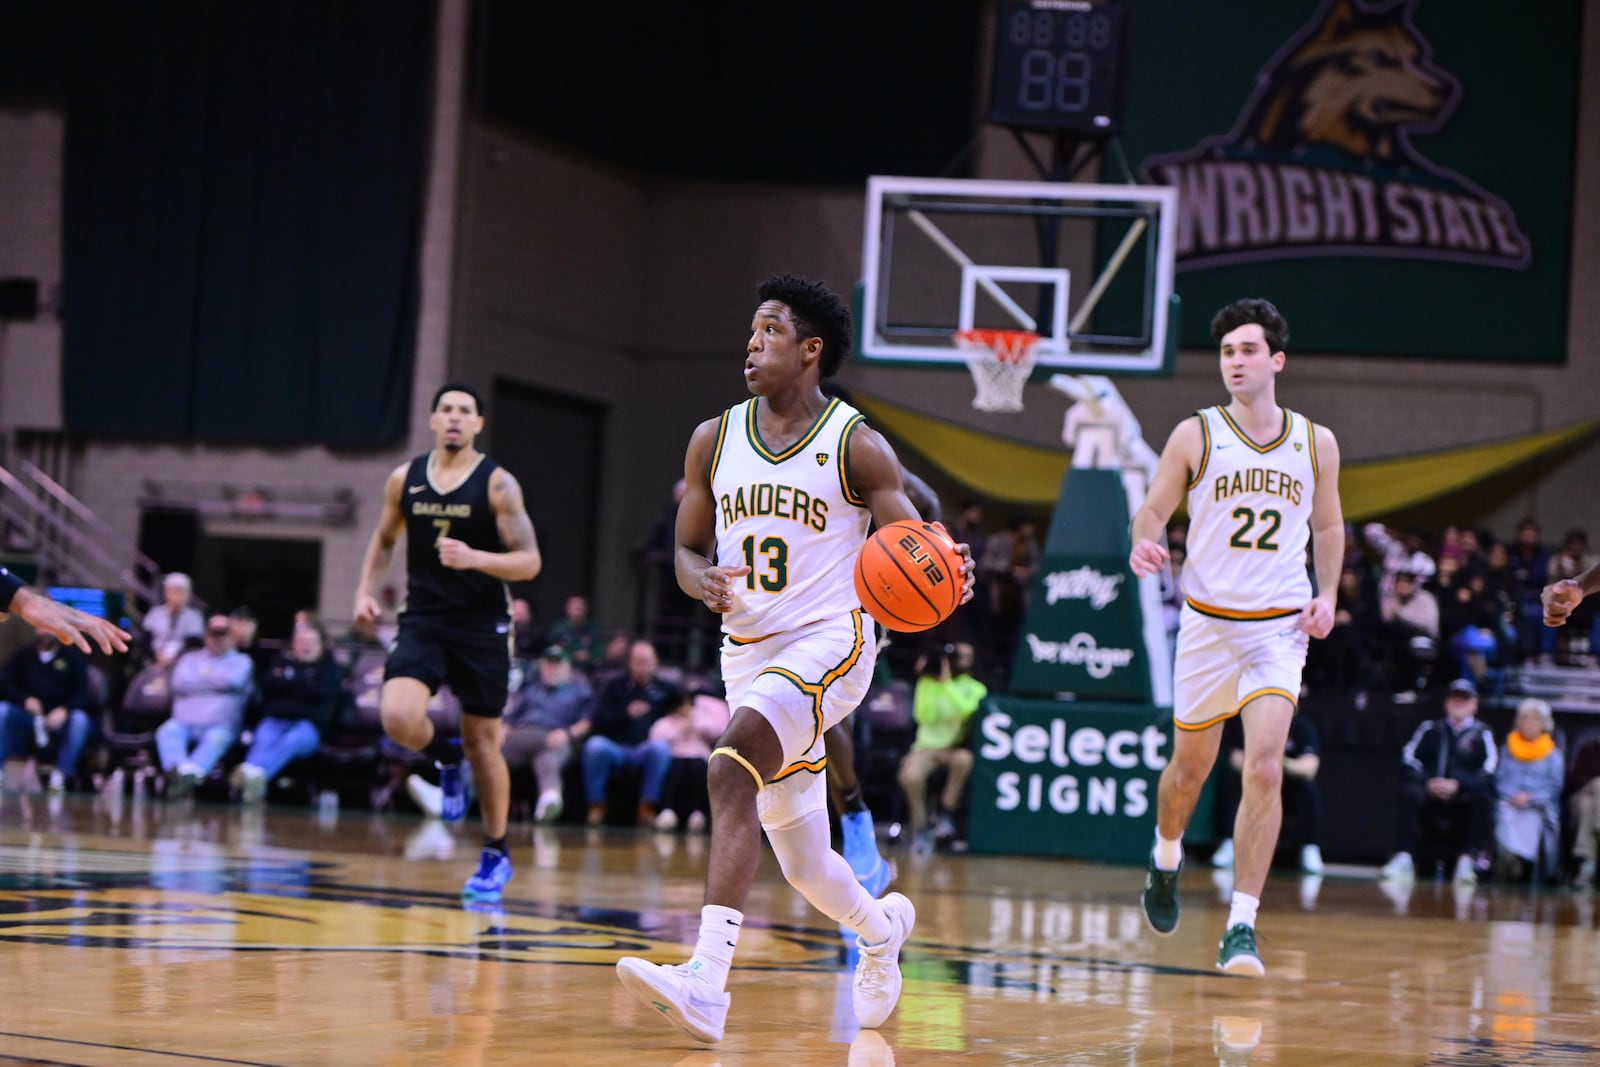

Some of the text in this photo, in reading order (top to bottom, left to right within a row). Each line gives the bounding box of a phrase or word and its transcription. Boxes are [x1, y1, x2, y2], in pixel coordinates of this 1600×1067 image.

[1162, 161, 1521, 255] WRIGHT STATE
[412, 501, 472, 518] OAKLAND
[720, 483, 829, 532] RAIDERS
[1214, 468, 1303, 505] RAIDERS
[432, 519, 451, 548] 7
[1230, 507, 1282, 551] 22
[742, 535, 788, 593] 13
[898, 534, 945, 587] ELITE
[980, 711, 1168, 771] Select
[995, 771, 1149, 818] SIGNS
